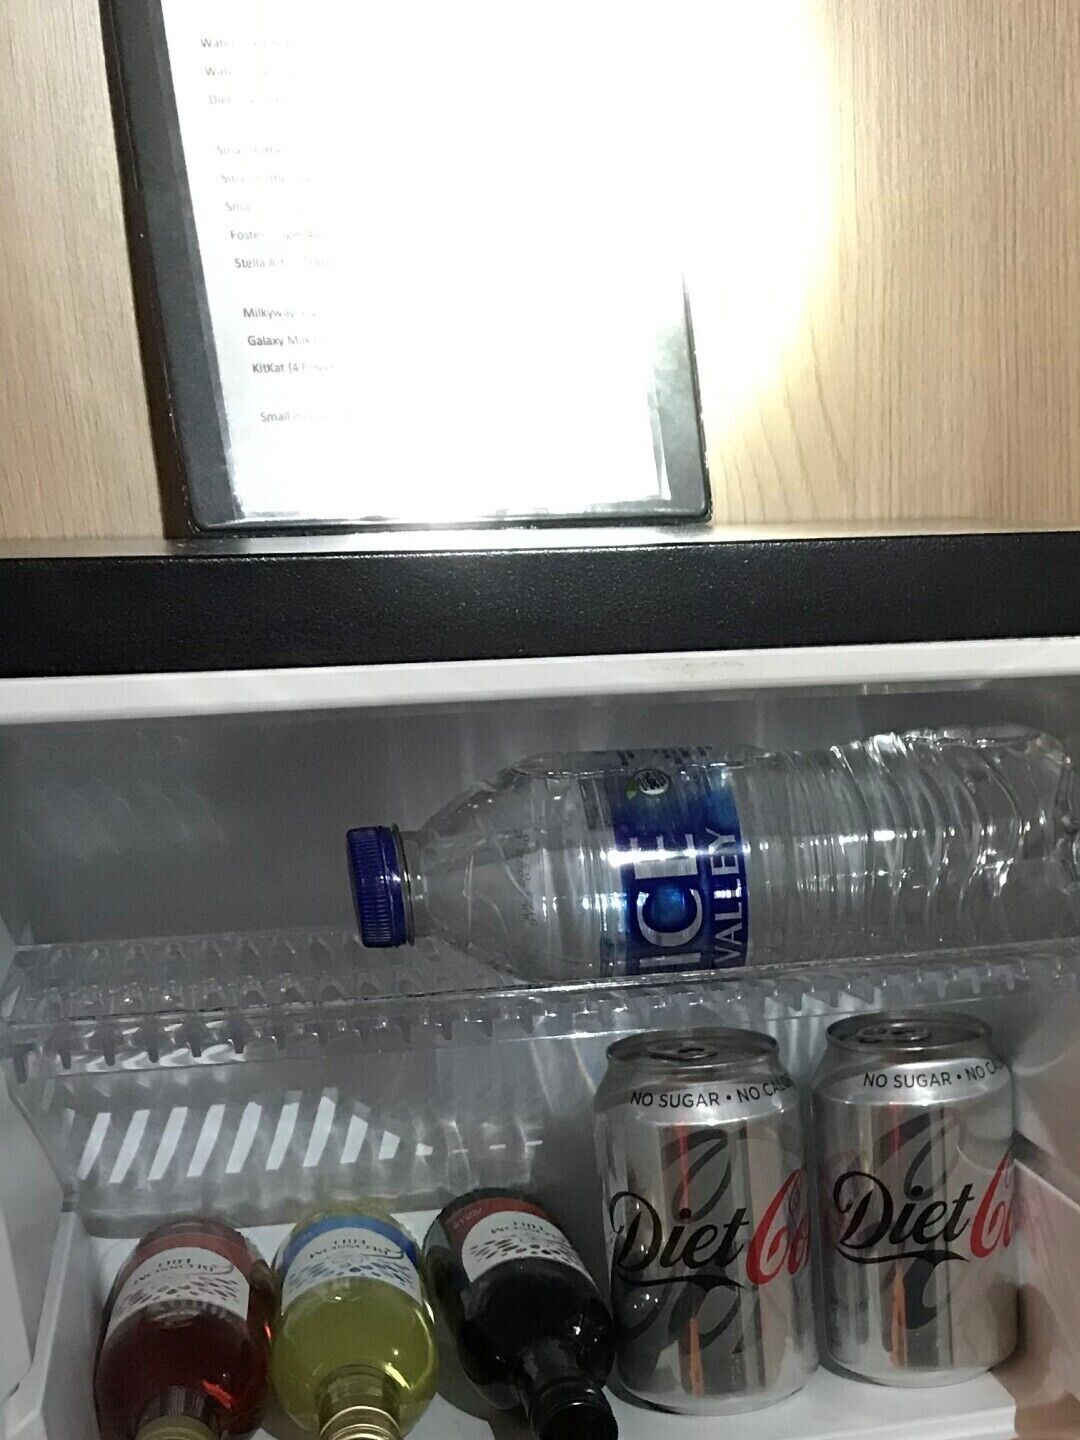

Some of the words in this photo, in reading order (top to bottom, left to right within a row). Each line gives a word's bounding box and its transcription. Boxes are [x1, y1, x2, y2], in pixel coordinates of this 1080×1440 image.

[247, 335, 284, 348] Galaxy
[252, 362, 285, 374] KitKat
[259, 411, 291, 424] Small
[705, 827, 743, 964] VALLEY
[863, 1073, 888, 1088] NO
[893, 1071, 952, 1089] SUGAR
[964, 1064, 985, 1082] NO
[631, 1091, 653, 1107] NO
[658, 1091, 720, 1108] SUGAR
[736, 1085, 761, 1103] NO
[833, 1170, 975, 1250] Diet
[609, 1190, 750, 1274] Diet
